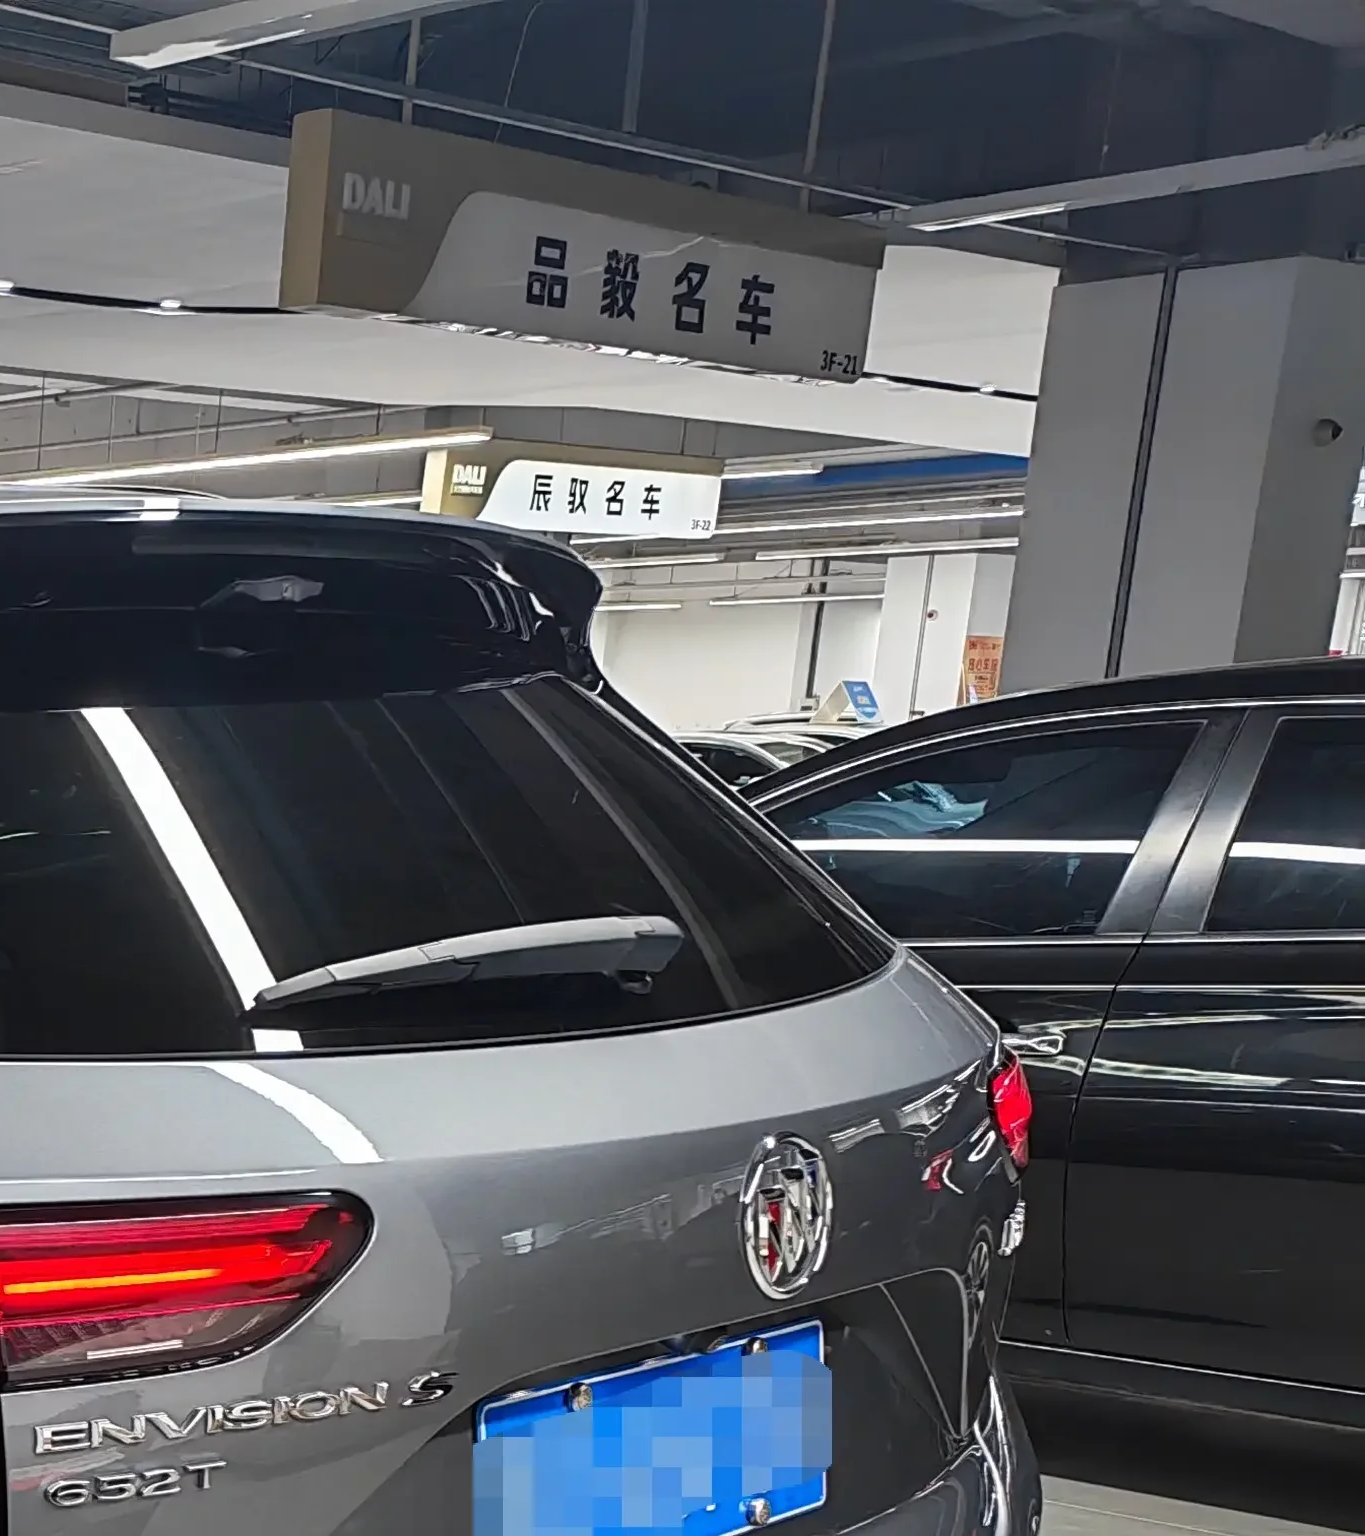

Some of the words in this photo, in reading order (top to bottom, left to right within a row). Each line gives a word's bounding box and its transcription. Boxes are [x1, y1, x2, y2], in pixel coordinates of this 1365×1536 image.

[341, 171, 411, 221] DALI
[525, 235, 776, 344] 品毅名车
[819, 349, 858, 377] 3F-21
[451, 463, 487, 486] DALI
[529, 473, 662, 521] 辰驭名车
[690, 518, 712, 532] 3F-22
[34, 1380, 389, 1455] ENVISION
[400, 1370, 459, 1407] S
[44, 1459, 228, 1508] 652T
